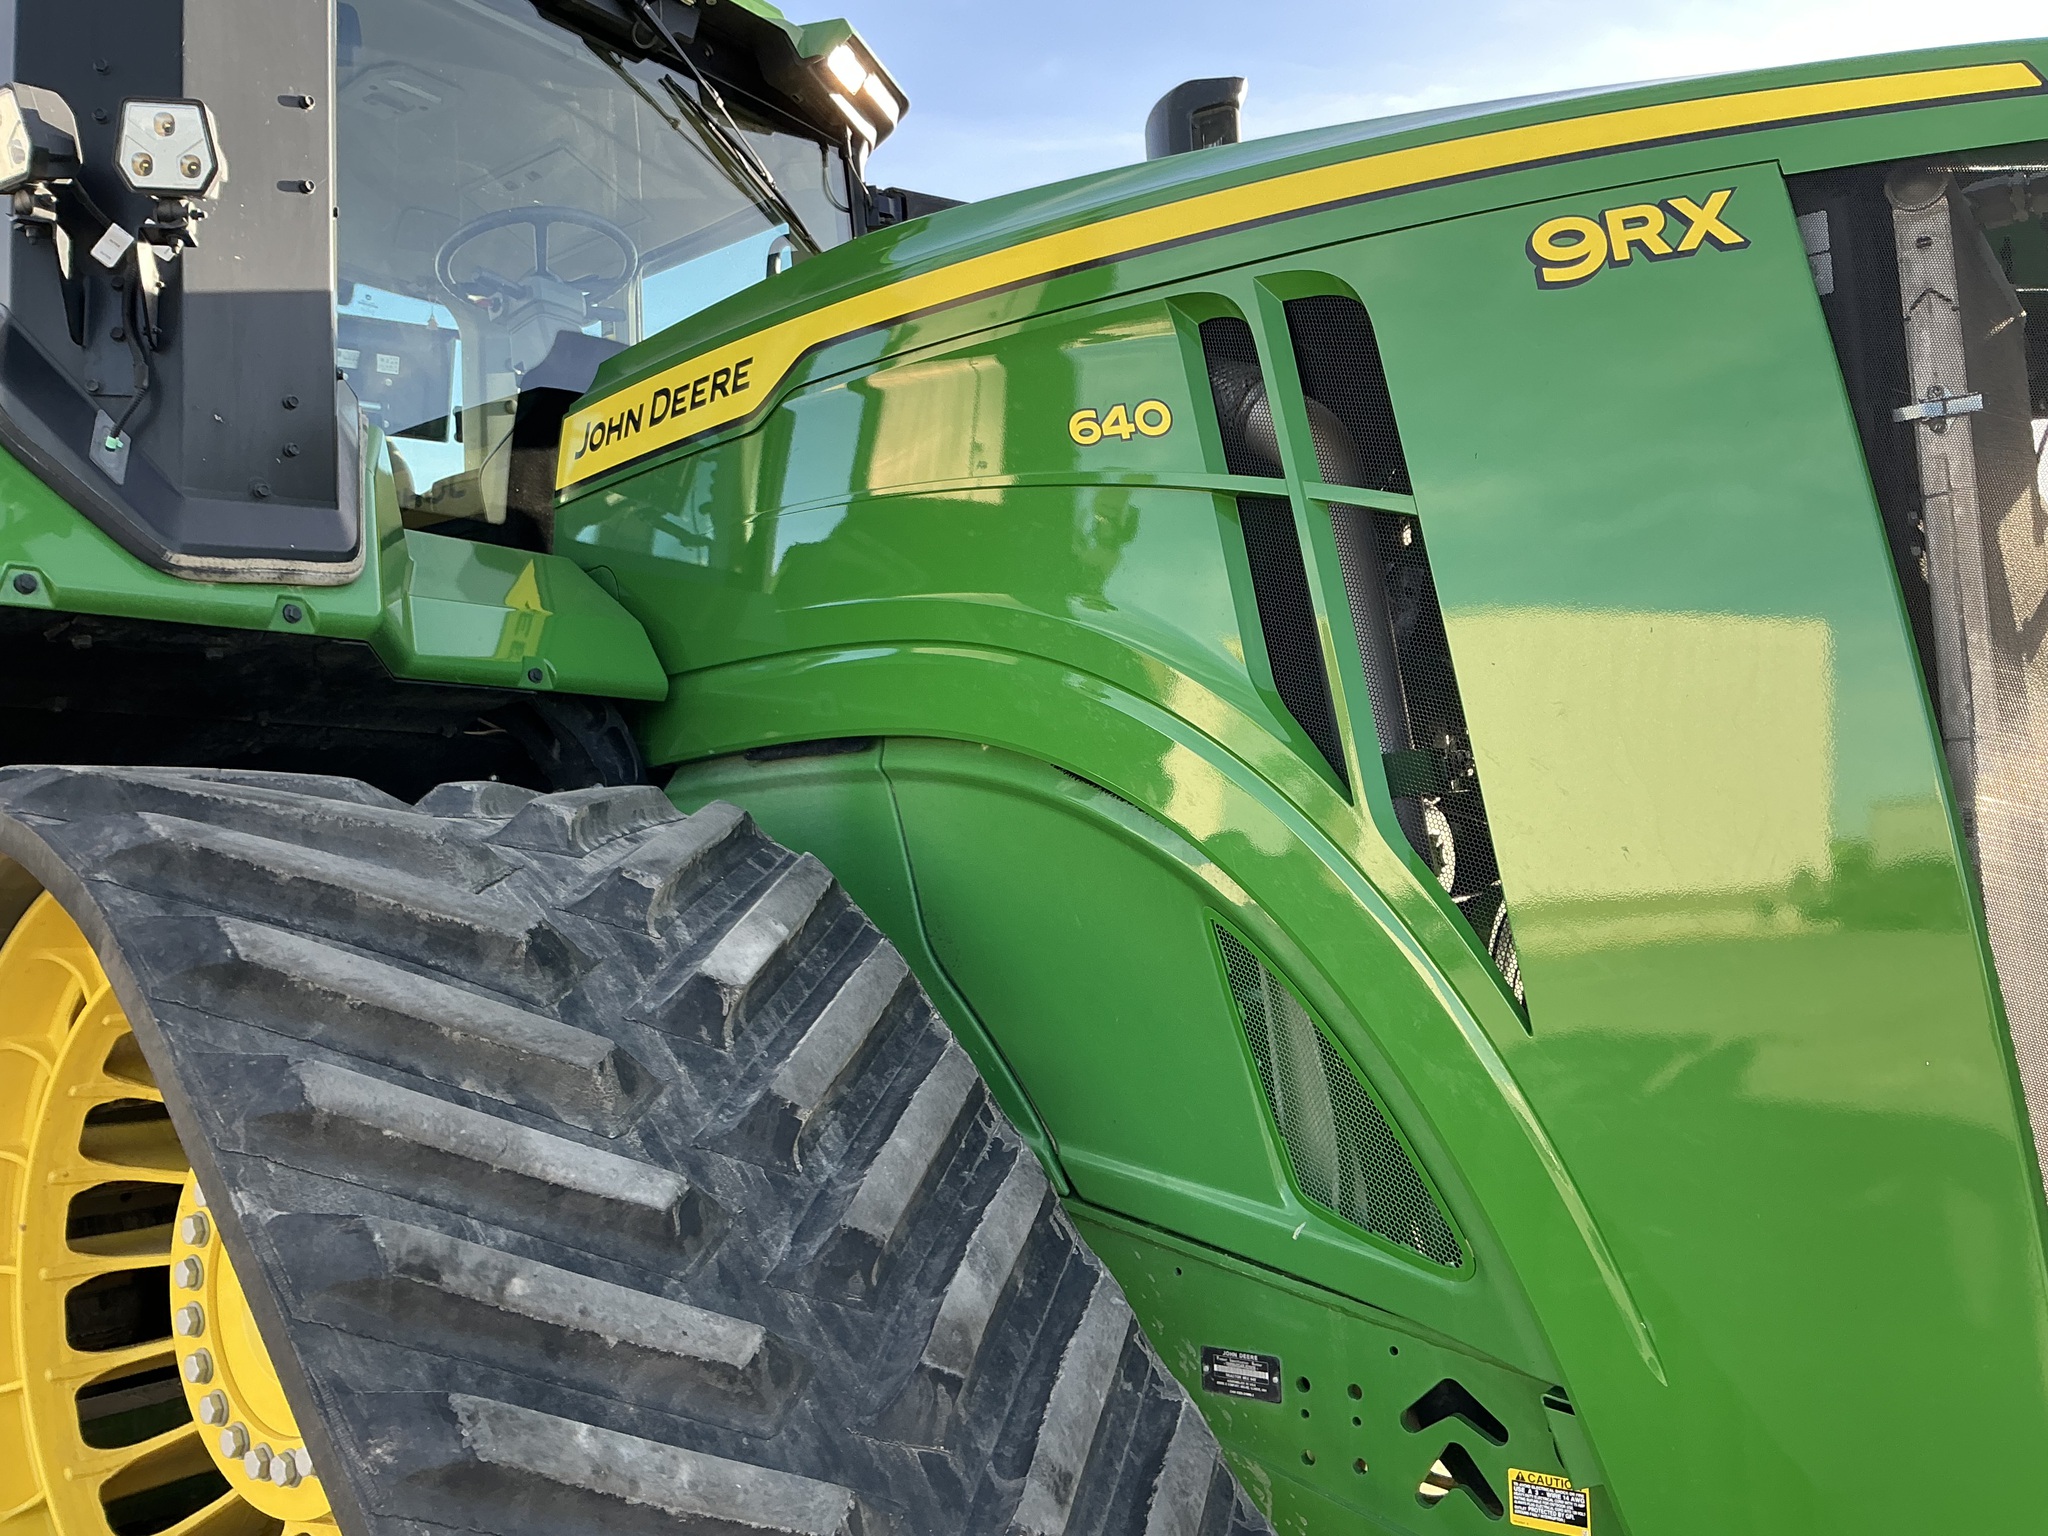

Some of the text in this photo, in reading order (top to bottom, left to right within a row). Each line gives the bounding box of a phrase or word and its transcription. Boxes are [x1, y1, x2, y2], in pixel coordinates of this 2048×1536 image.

[1525, 186, 1752, 290] 9RX
[574, 356, 754, 461] JOHN DEERE
[1068, 398, 1172, 446] 640
[1222, 1350, 1238, 1358] JOHN
[1239, 1353, 1258, 1361] DEERE
[1527, 1473, 1572, 1490] CAUTIO
